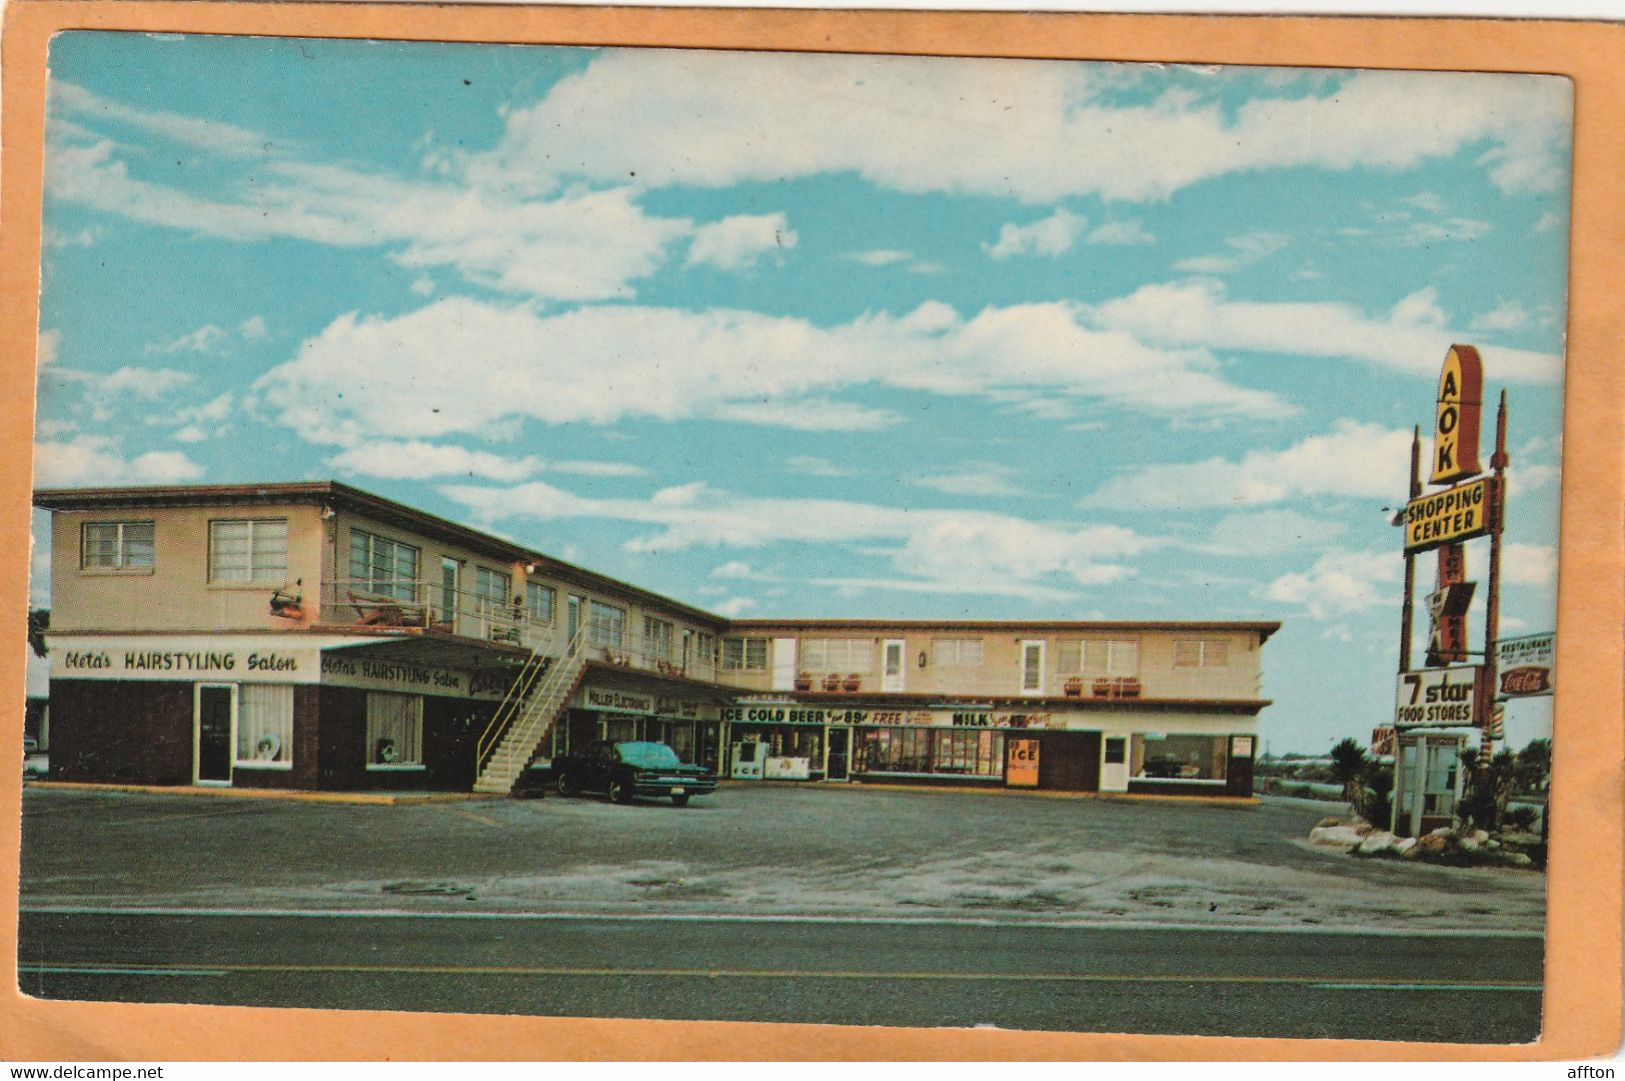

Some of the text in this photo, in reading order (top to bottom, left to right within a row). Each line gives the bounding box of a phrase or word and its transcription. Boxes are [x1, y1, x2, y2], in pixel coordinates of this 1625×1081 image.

[1408, 485, 1483, 524] SHOPPING
[1412, 508, 1475, 542] CENTER
[1500, 637, 1553, 654] RESTAURANT
[124, 652, 236, 671] HAIRSTYLING
[247, 652, 298, 672] Salon
[362, 661, 430, 685] HAIRSTYLING
[1404, 672, 1474, 705] 7 star
[720, 708, 743, 721] ICE
[747, 709, 783, 722] COLD
[789, 709, 824, 723] BEER
[872, 712, 902, 725] FREE
[952, 713, 989, 726] MILK
[1398, 704, 1471, 722] FOOD STORES
[1011, 750, 1036, 761] ICE
[733, 767, 761, 775] ICE
